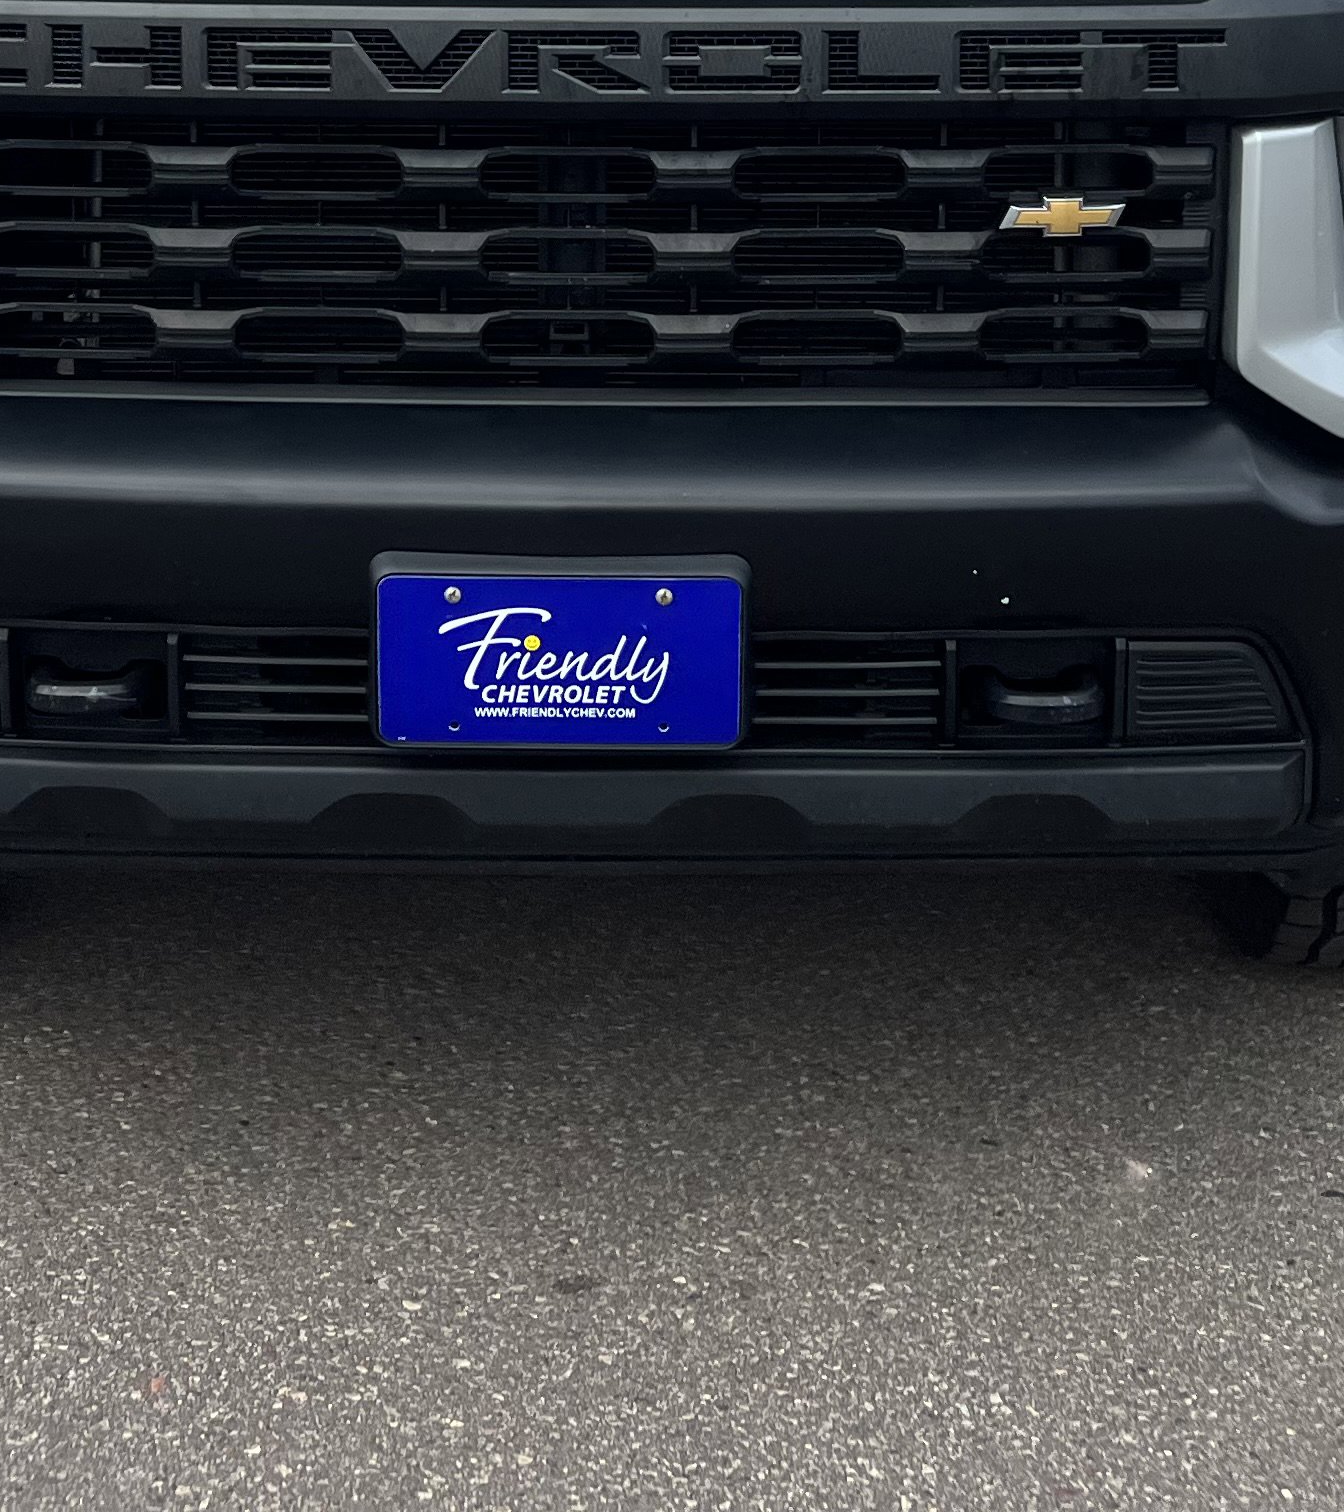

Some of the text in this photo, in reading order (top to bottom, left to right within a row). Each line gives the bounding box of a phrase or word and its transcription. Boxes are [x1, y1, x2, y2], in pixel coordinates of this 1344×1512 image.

[439, 607, 670, 705] Friendly
[481, 685, 626, 704] CHEVROLET
[474, 707, 636, 719] WWW.FRIENDLYCHEV.COM
